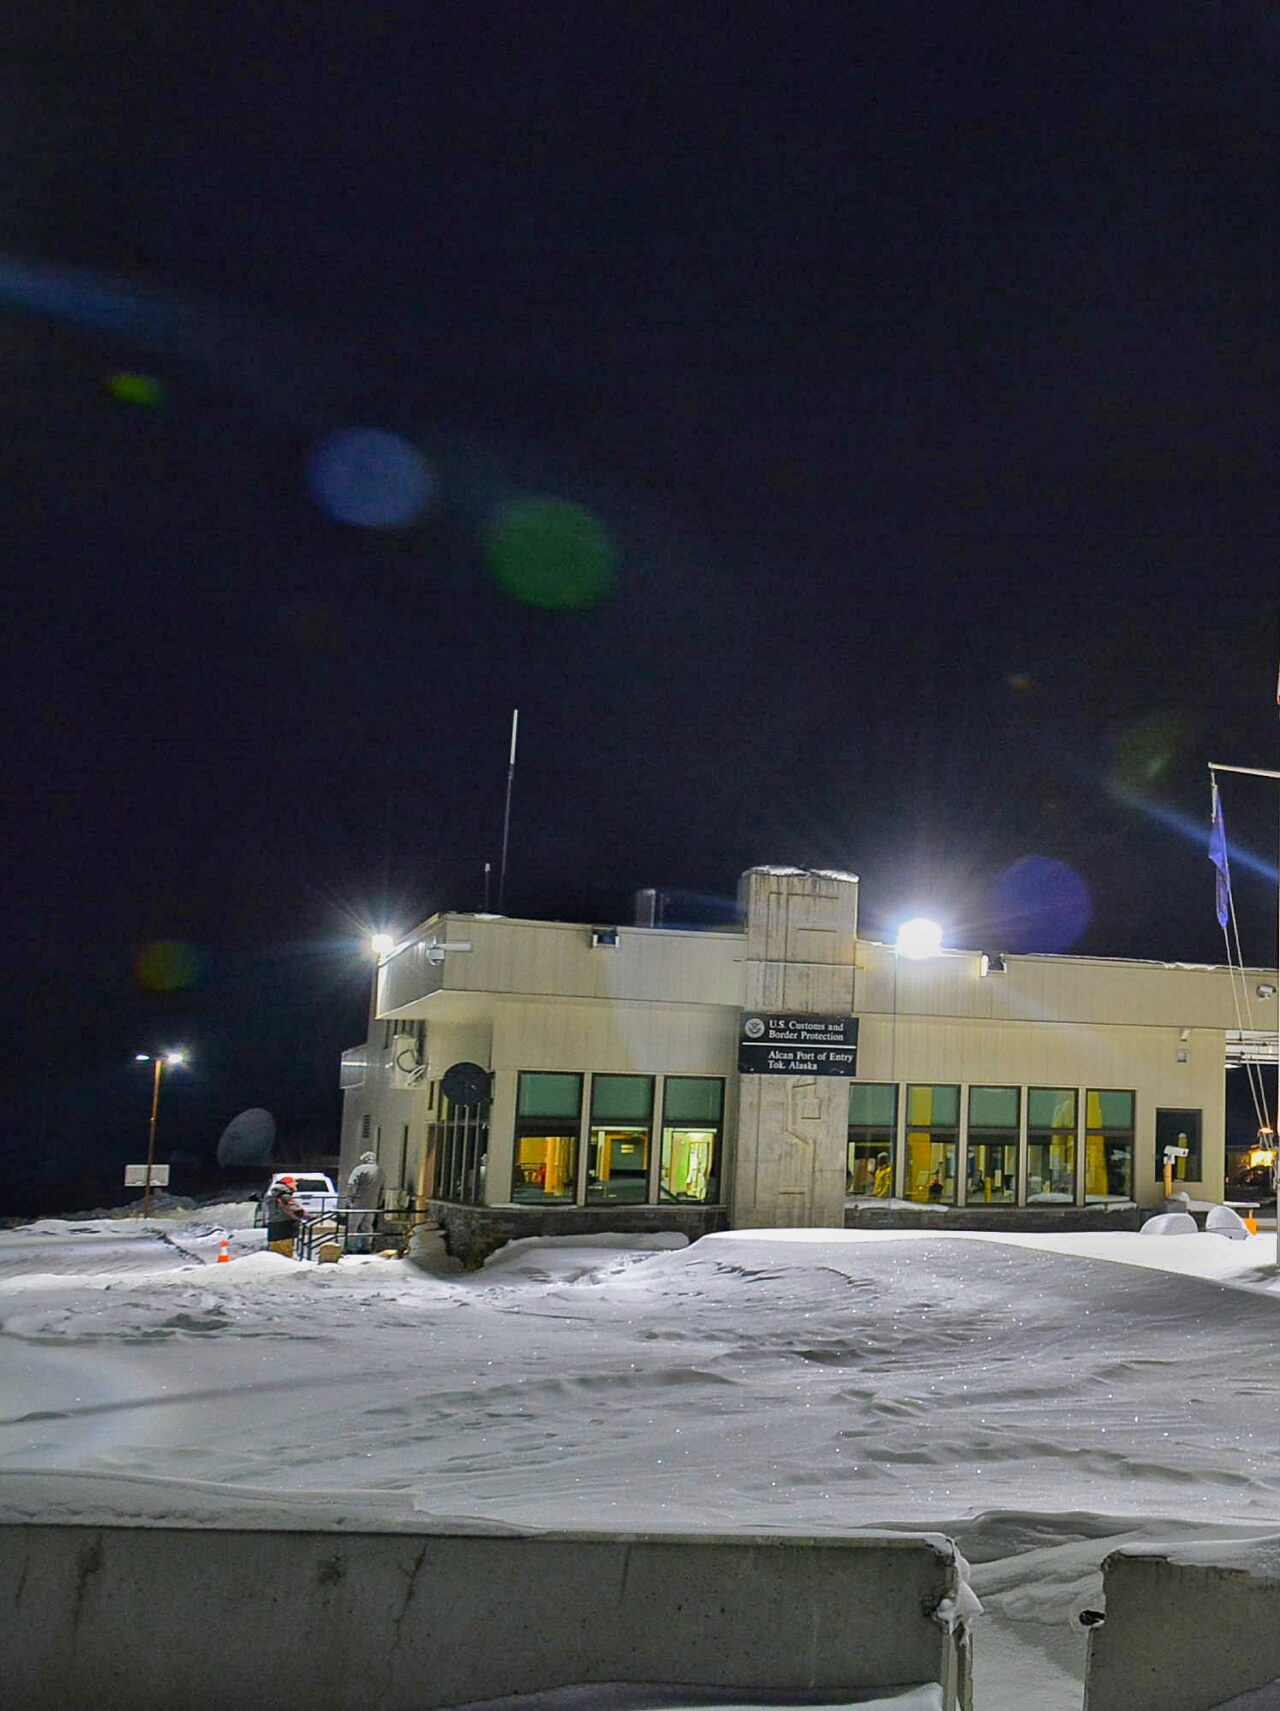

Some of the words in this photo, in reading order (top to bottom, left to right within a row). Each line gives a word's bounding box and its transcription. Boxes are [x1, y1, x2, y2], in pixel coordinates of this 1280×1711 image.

[769, 1020, 786, 1029] U.S.
[788, 1021, 825, 1031] Customs
[827, 1023, 844, 1031] and
[768, 1030, 798, 1039] Border
[800, 1031, 844, 1041] Protection
[768, 1050, 794, 1060] Alcan
[796, 1051, 815, 1061] Port
[816, 1051, 828, 1061] of
[829, 1052, 854, 1063] Entry
[788, 1061, 818, 1071] Alaska
